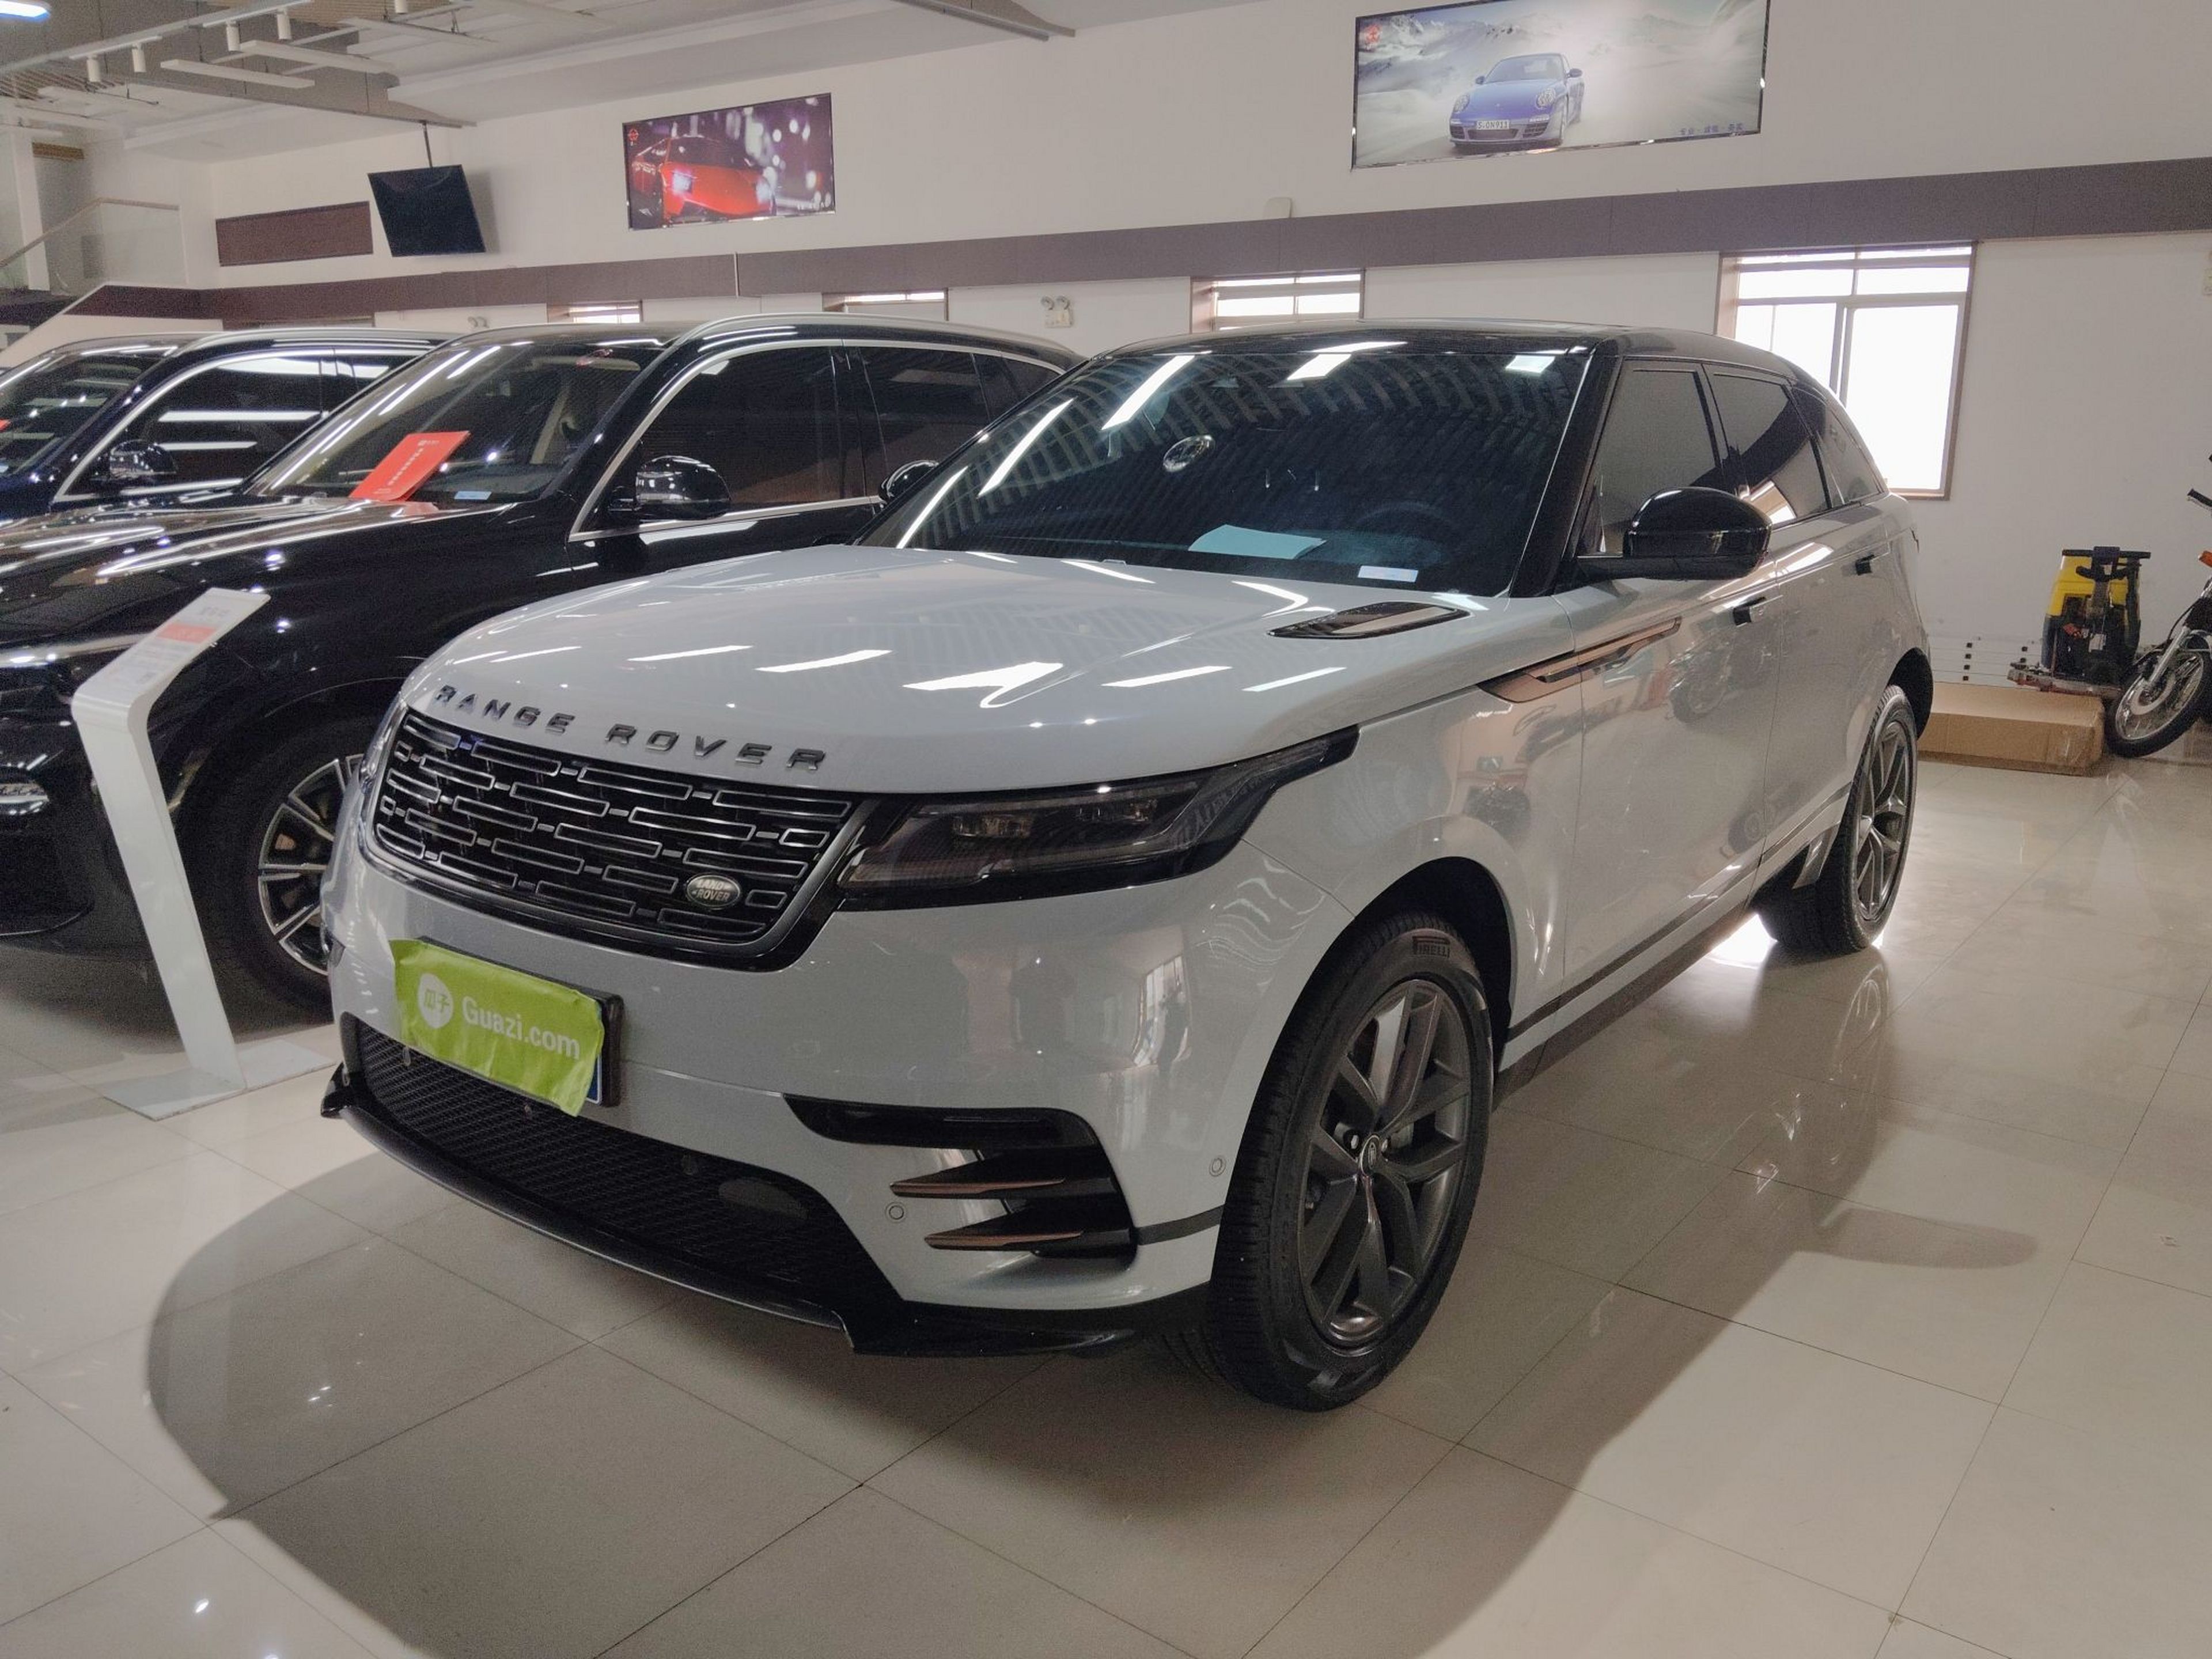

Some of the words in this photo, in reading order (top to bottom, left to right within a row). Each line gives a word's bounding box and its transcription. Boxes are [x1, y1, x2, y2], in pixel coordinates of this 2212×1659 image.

[436, 685, 575, 731] RANGE
[604, 724, 825, 770] ROVER
[696, 878, 725, 890] LAND
[696, 888, 730, 902] ROVER
[1412, 935, 1450, 957] PIRELLI
[423, 988, 449, 1012] 瓜子
[463, 996, 580, 1060] Guazi.com
